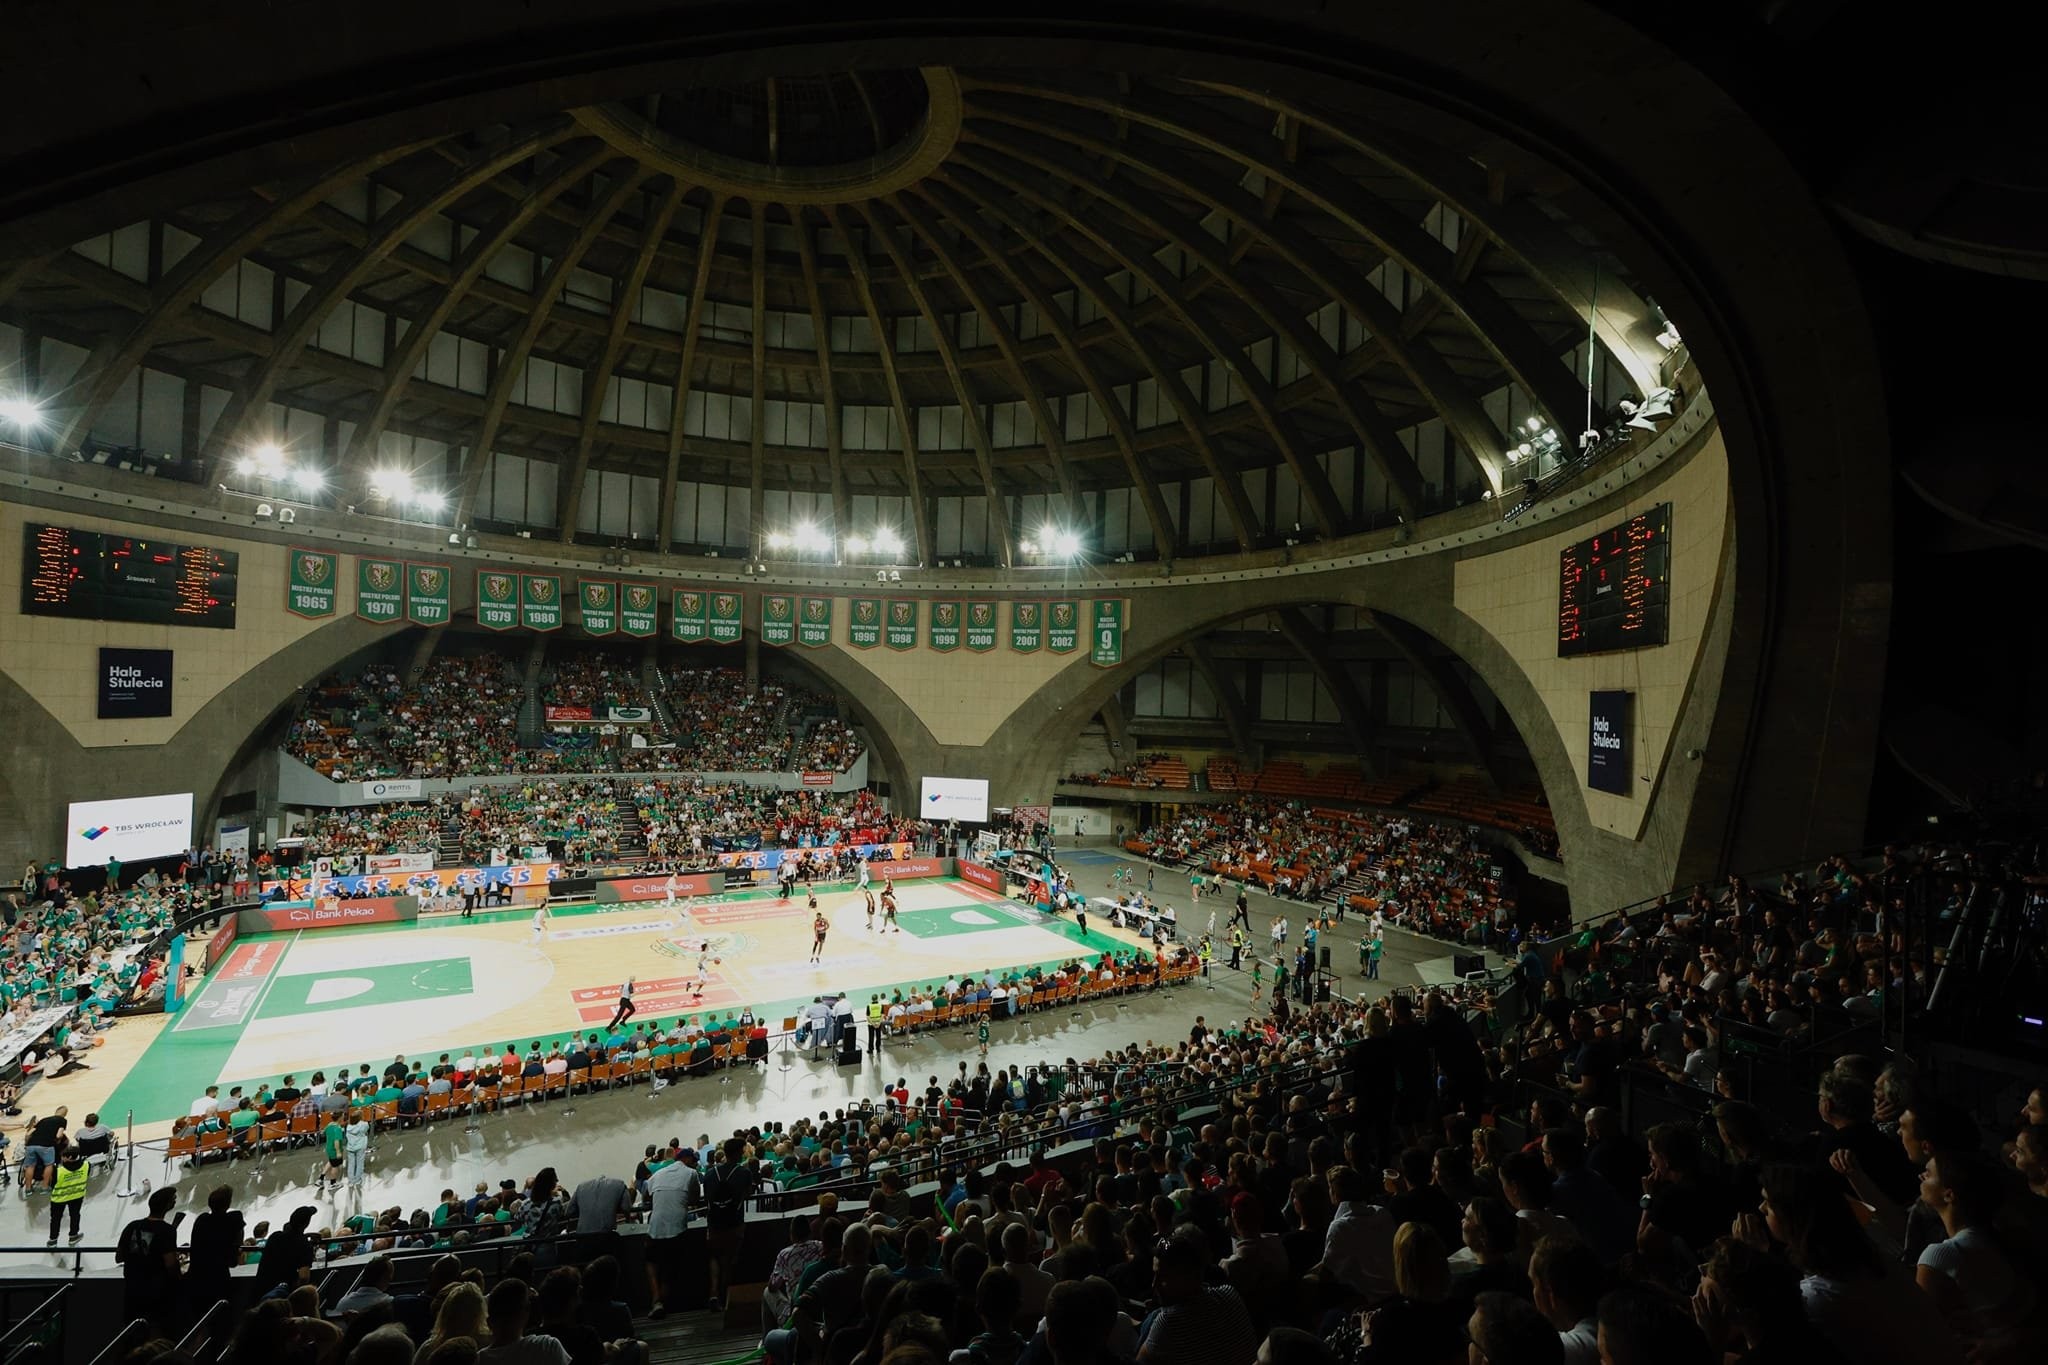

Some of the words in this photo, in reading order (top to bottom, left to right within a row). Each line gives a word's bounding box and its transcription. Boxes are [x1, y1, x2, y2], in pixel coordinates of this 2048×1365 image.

[296, 595, 328, 610] 1965
[365, 601, 395, 615] 1970
[417, 605, 441, 618] 1977
[486, 610, 512, 623] 1979
[587, 617, 609, 629] 1981
[628, 618, 650, 630] 1987
[679, 625, 701, 636] 1991
[714, 626, 736, 637] 1992
[767, 629, 788, 639] 1993
[935, 635, 955, 645] 1999
[970, 635, 992, 645] 2000
[1016, 636, 1037, 646] 2001
[1051, 636, 1073, 647] 2002
[1101, 629, 1112, 650] 9
[109, 665, 142, 677] Hala
[109, 677, 164, 688] Stulecia
[1593, 716, 1609, 732] Hala
[1592, 732, 1621, 749] Stulecia
[115, 824, 133, 832] TBS
[135, 819, 184, 831] WROCŁAW
[502, 867, 530, 885] STS
[315, 910, 341, 919] Bank
[343, 907, 375, 917] Pekao
